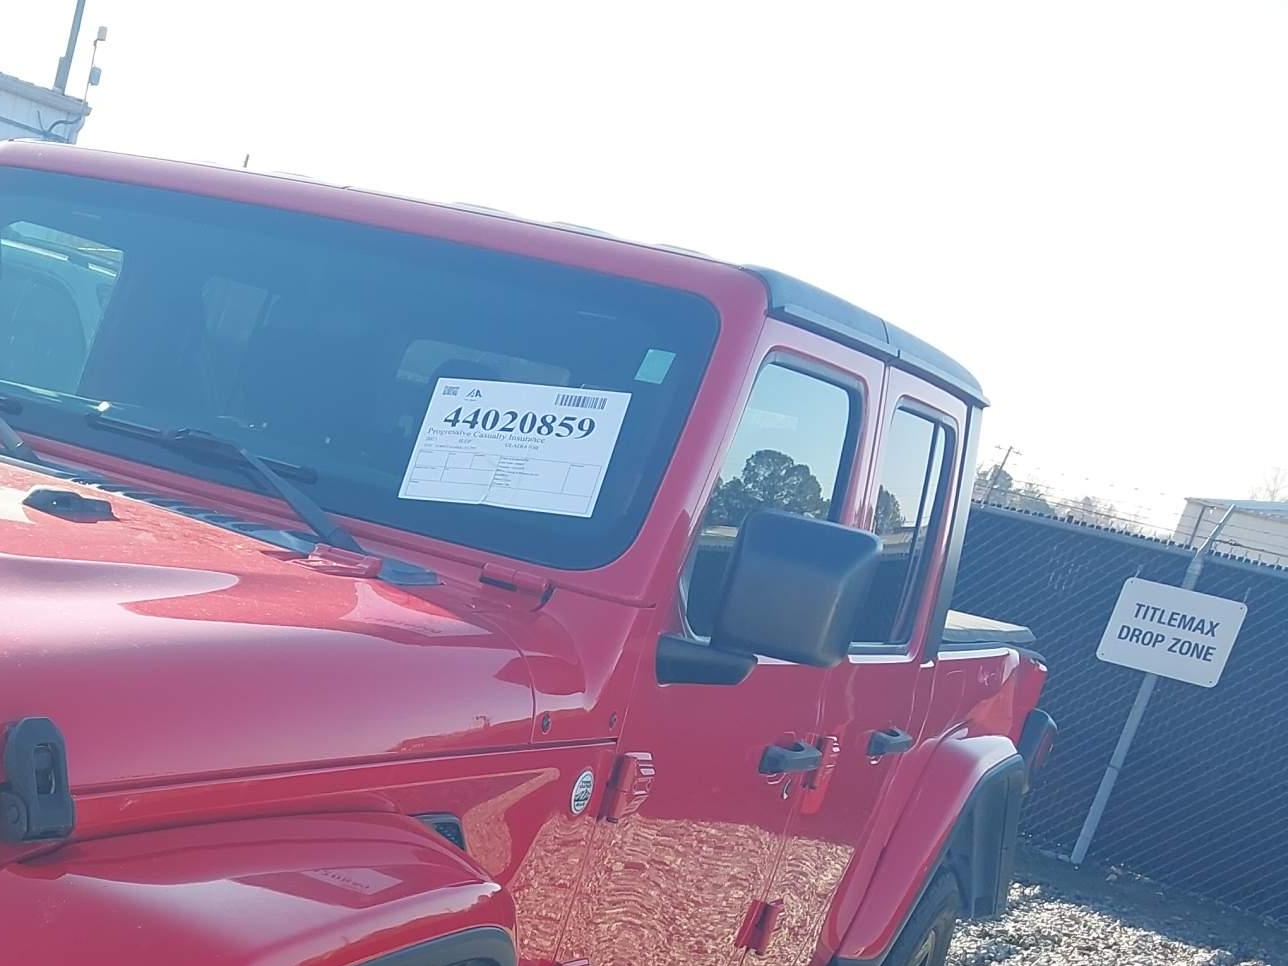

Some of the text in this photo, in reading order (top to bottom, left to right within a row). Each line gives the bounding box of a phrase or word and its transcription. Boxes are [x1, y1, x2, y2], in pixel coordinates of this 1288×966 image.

[427, 427, 546, 443] Progressive Casualty Insurance
[443, 406, 596, 440] 44020859
[1133, 602, 1221, 637] TITLEMAX
[1117, 625, 1217, 662] DROP ZONE
